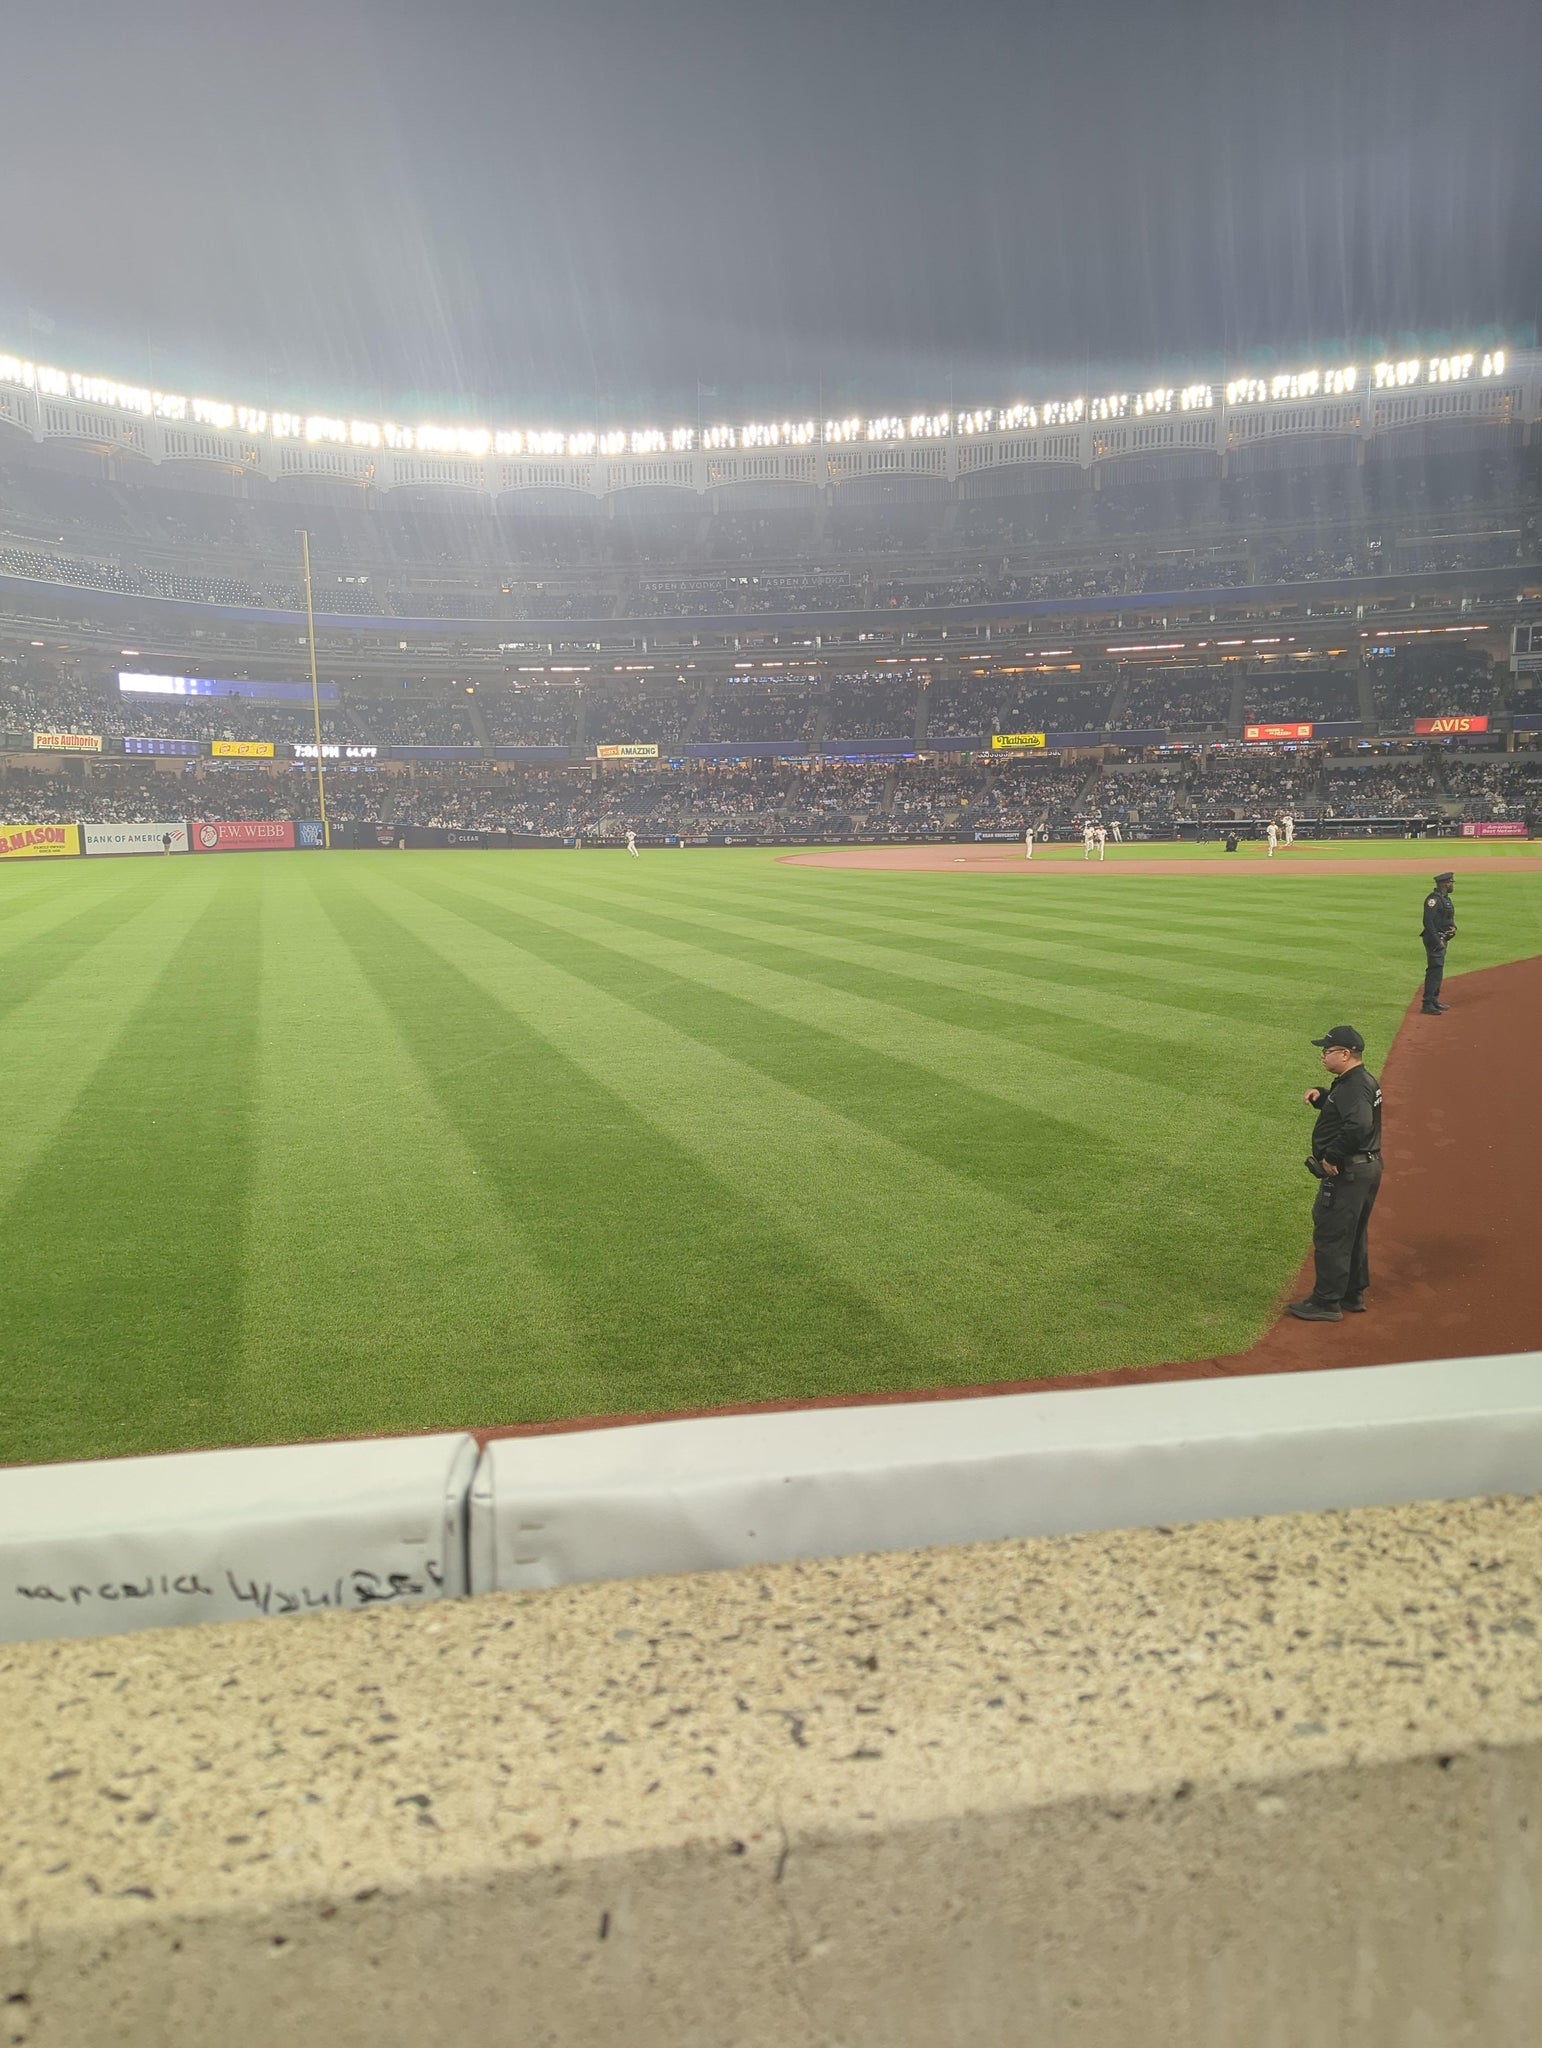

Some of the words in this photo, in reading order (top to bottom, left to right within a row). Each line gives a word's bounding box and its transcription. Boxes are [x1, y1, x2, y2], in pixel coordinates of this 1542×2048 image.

[645, 583, 677, 591] ASPEN
[689, 581, 722, 589] VODKA
[766, 578, 799, 586] ASPEN
[811, 576, 845, 584] VODKA
[1430, 718, 1470, 732] AVIS
[36, 735, 60, 745] Parts
[60, 735, 99, 747] Authority
[996, 735, 1040, 747] Nathan's
[321, 746, 339, 757] PM
[620, 747, 656, 756] AMAZING
[245, 825, 285, 837] WEBB
[87, 835, 113, 844] BANK
[115, 835, 126, 843] OF
[128, 834, 162, 842] AMERIC
